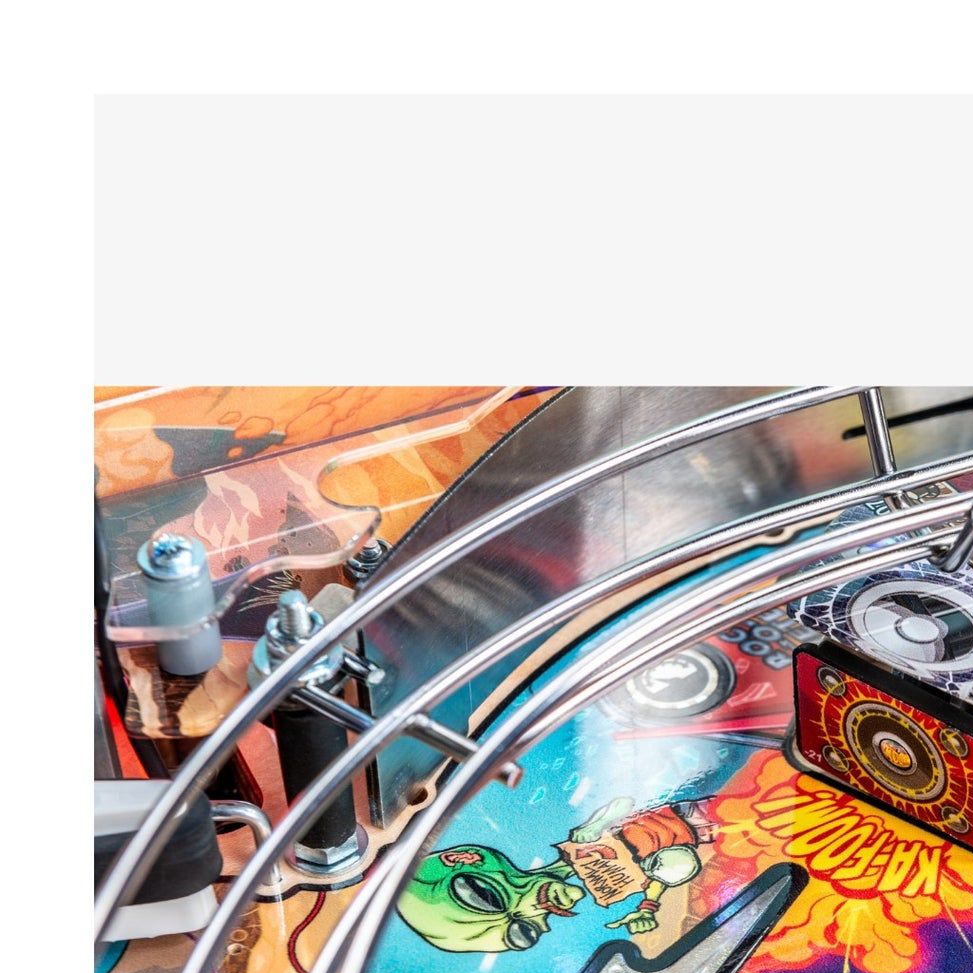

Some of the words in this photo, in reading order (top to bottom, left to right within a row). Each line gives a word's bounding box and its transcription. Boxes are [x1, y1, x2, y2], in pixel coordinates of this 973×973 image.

[750, 790, 943, 898] KA-FOOM!
[580, 859, 635, 889] HUMAN
[583, 866, 623, 901] NORMAL
